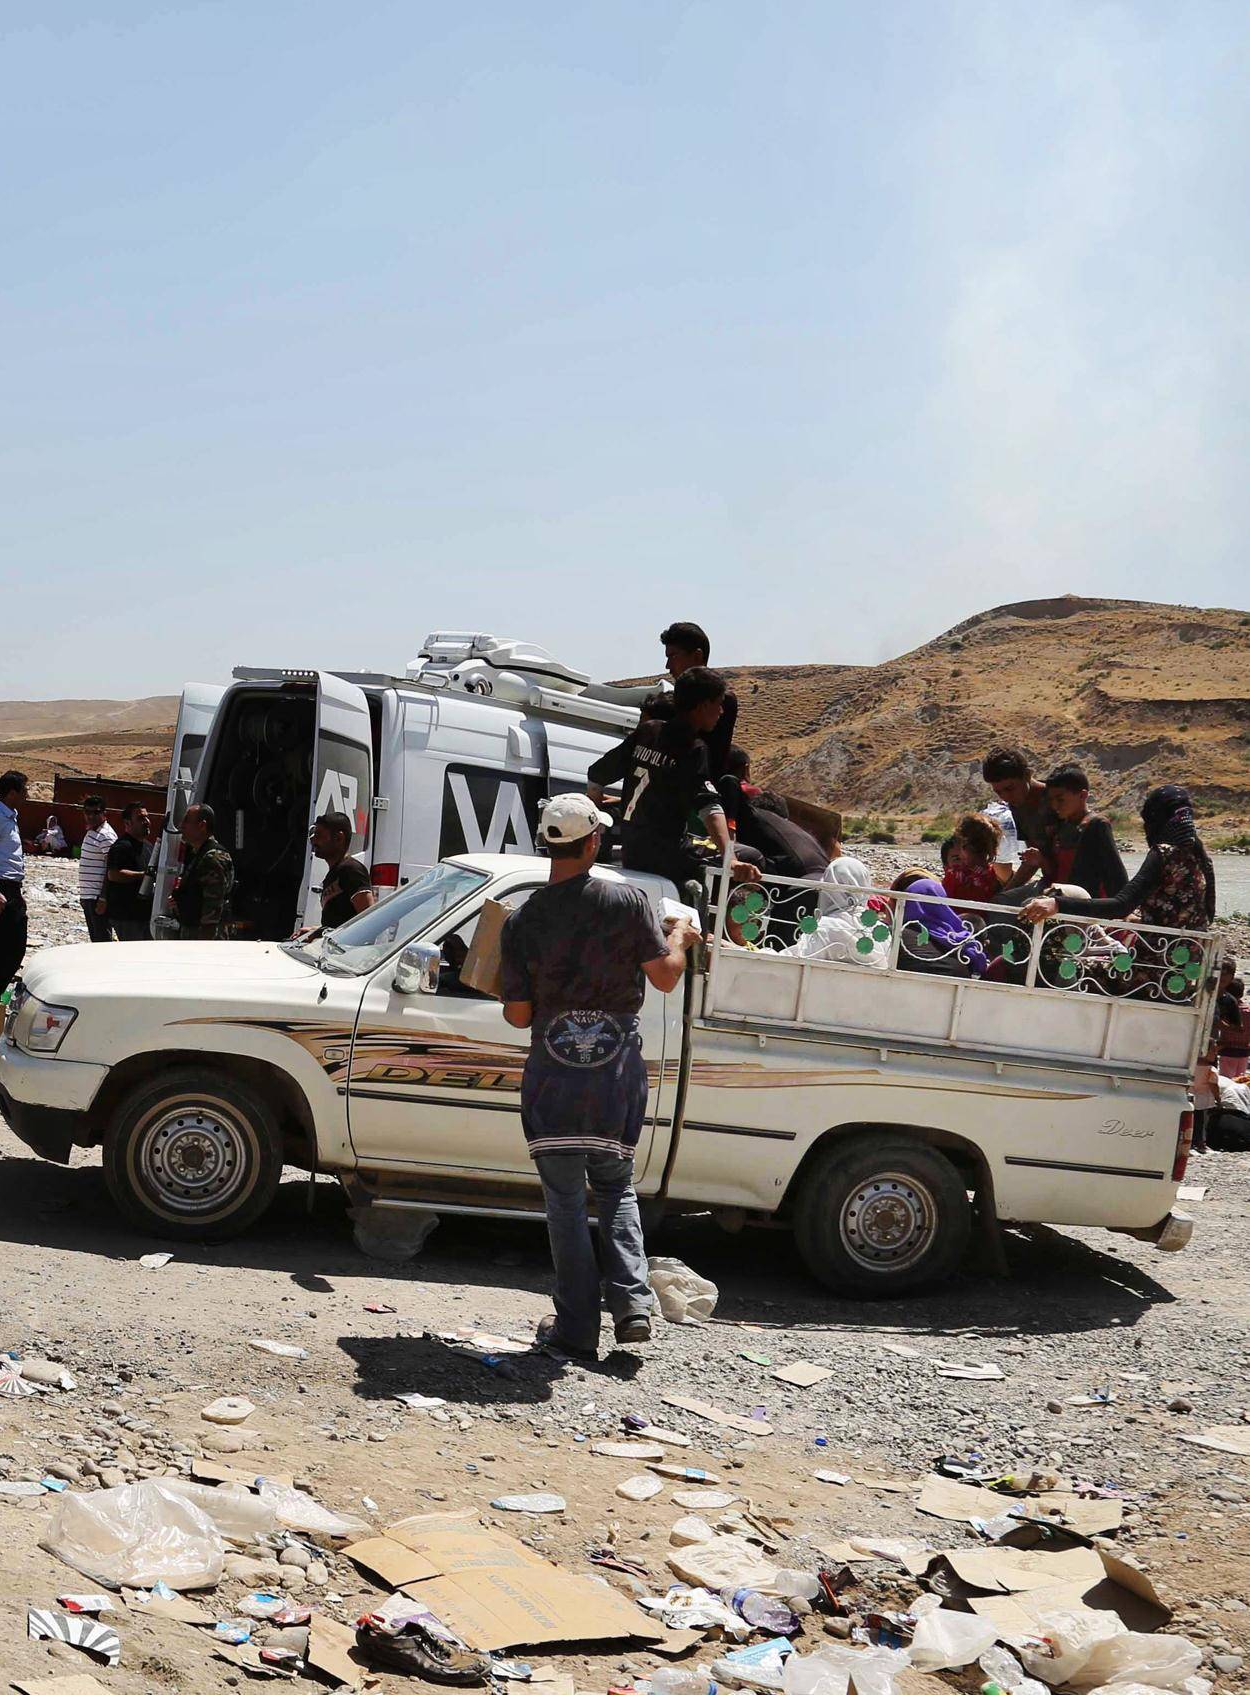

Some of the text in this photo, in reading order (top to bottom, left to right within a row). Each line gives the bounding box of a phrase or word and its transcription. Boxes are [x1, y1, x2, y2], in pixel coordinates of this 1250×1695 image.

[623, 766, 650, 821] 7
[573, 1016, 598, 1024] NAVY
[1095, 1119, 1156, 1139] Deer
